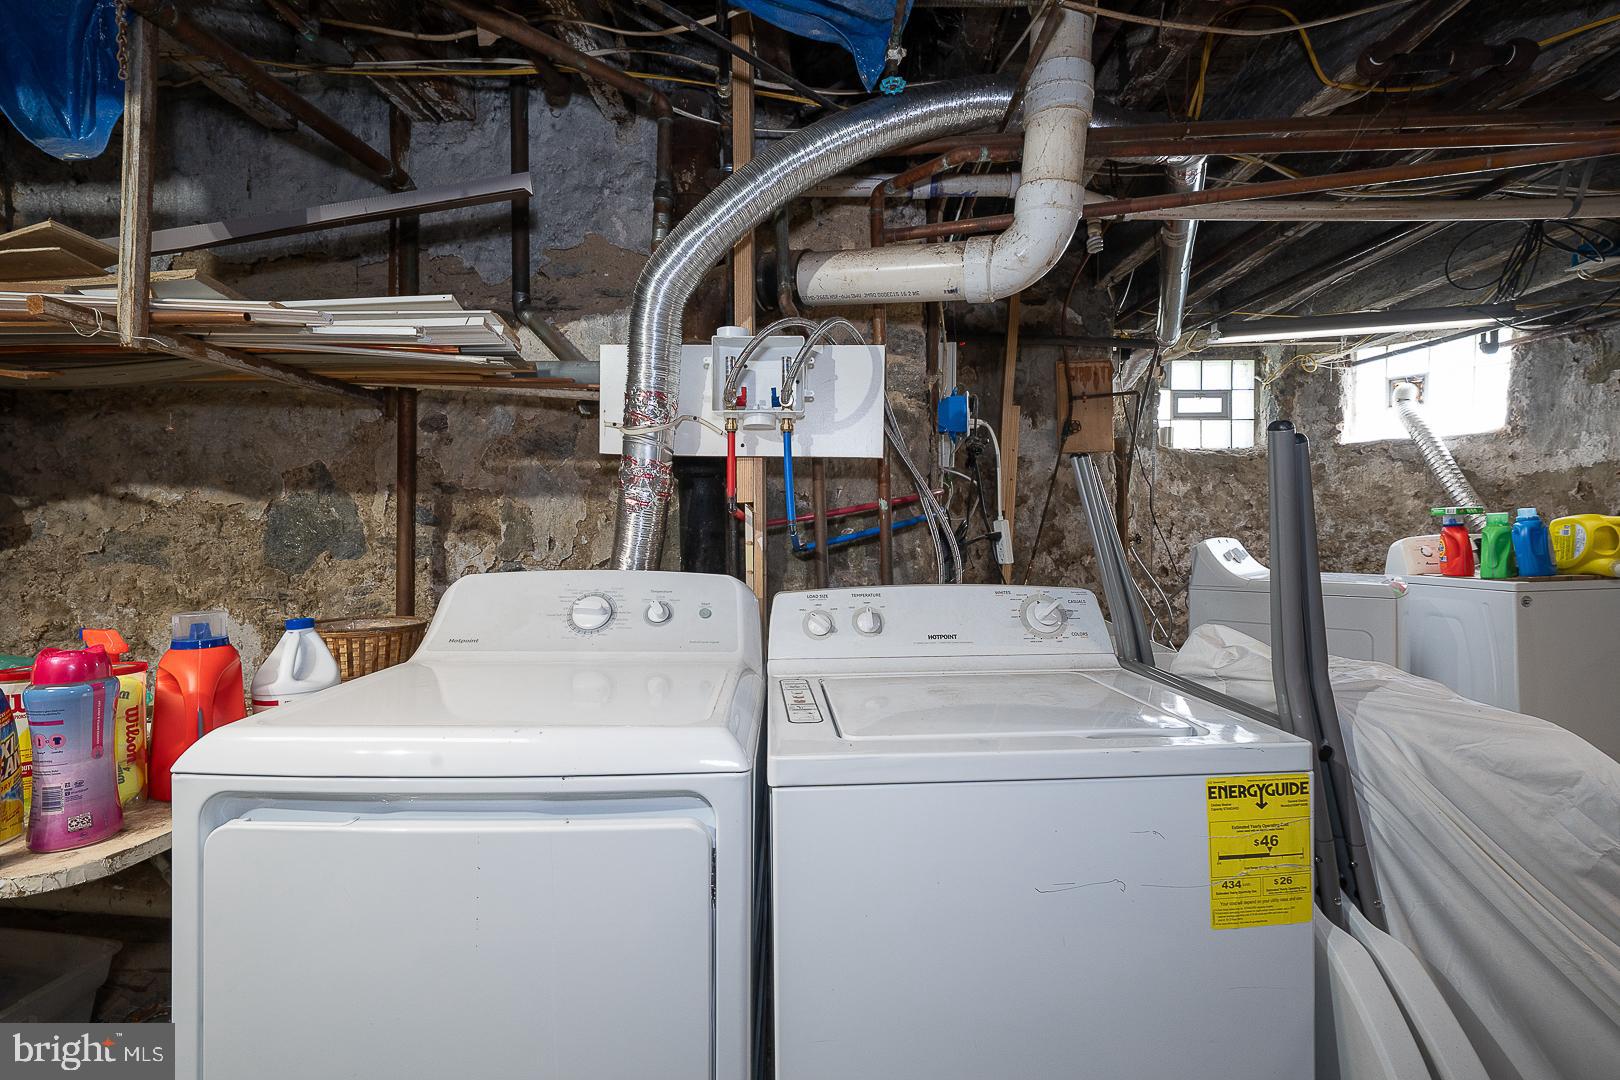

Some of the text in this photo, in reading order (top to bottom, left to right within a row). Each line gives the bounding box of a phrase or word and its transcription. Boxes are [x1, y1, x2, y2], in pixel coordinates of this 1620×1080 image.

[125, 705, 139, 764] Wilson
[1208, 781, 1309, 800] ENERGYGUIDE
[1221, 880, 1242, 890] 434
